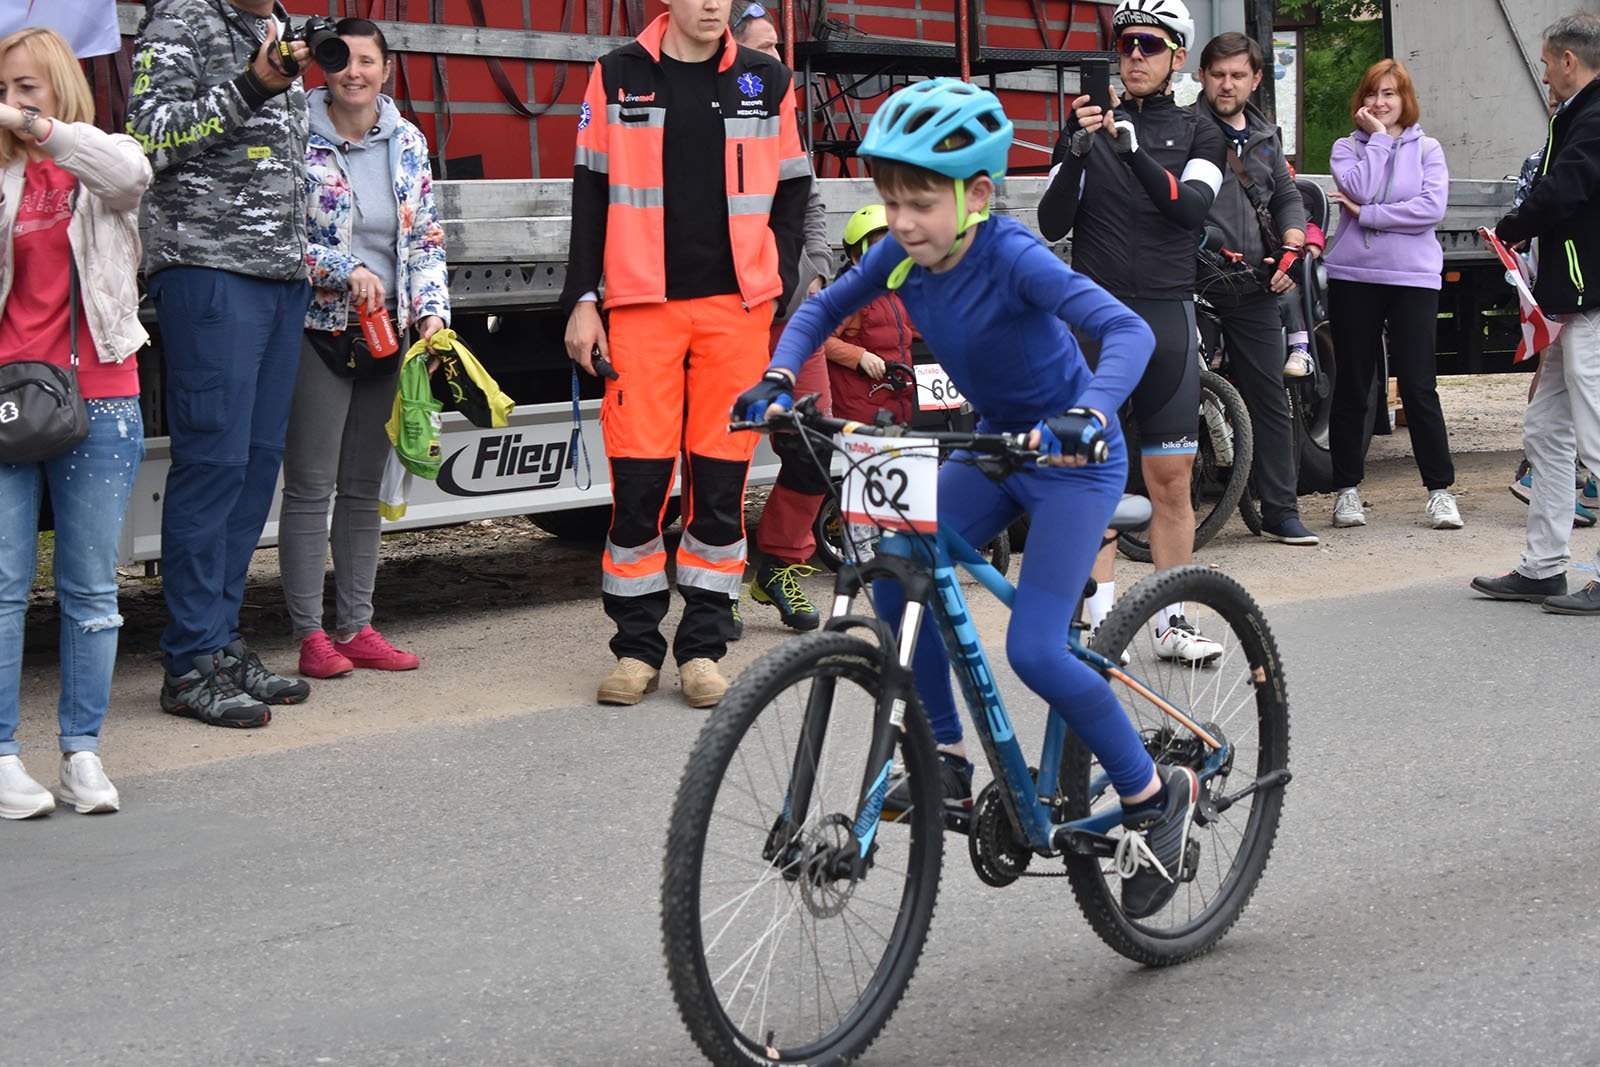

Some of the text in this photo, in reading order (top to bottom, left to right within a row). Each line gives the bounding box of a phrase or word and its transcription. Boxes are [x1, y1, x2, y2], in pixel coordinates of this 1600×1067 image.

[931, 378, 960, 401] 66
[1162, 441, 1182, 449] bike
[866, 465, 910, 512] 62
